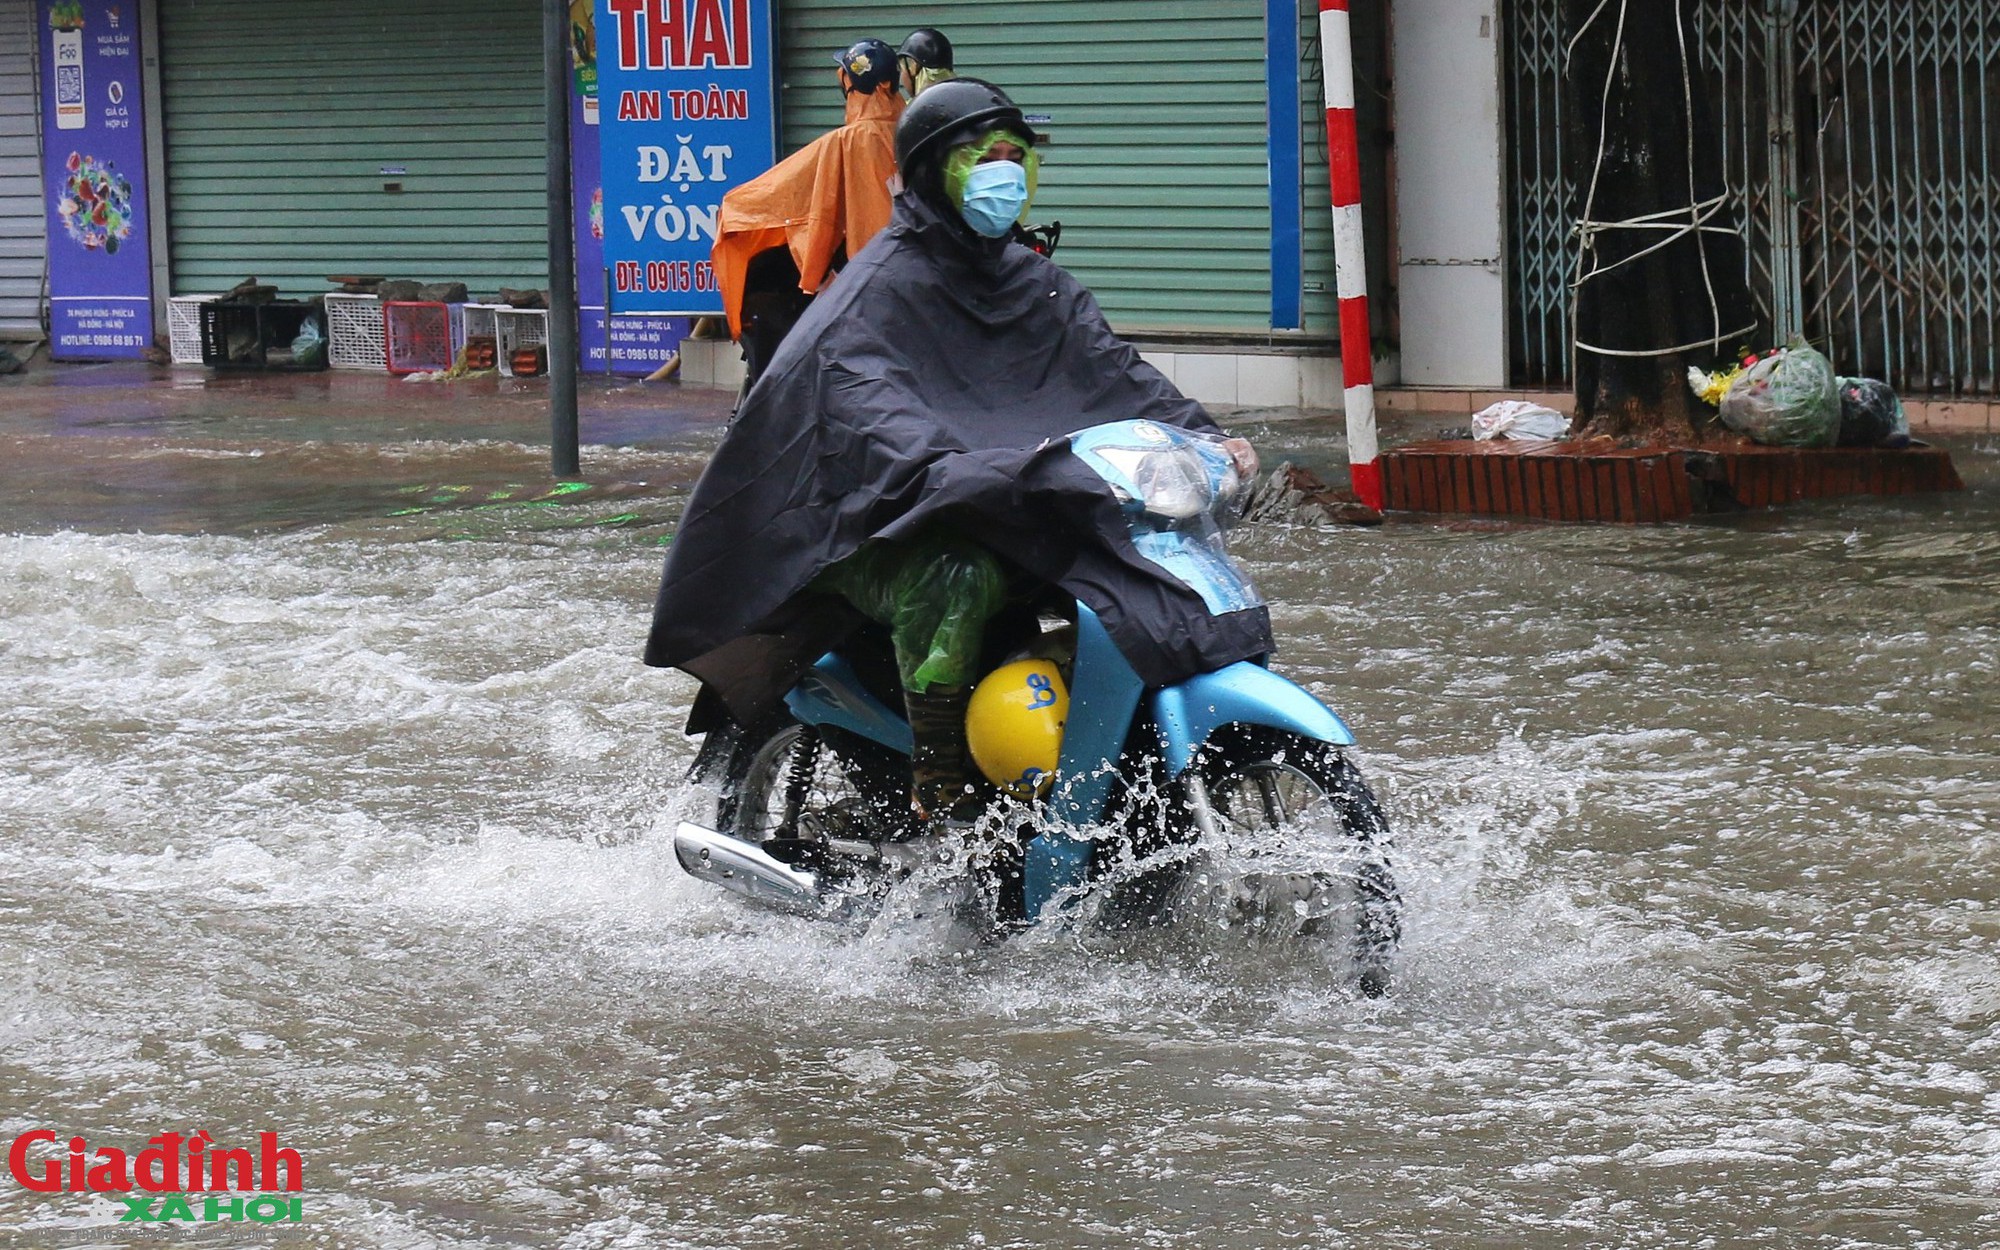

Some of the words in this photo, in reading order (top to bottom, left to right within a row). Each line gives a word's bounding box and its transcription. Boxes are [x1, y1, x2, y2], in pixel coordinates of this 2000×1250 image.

[97, 35, 114, 43] MUA
[617, 89, 661, 121] AN
[668, 83, 748, 120] TOÀN
[637, 134, 732, 192] ĐẶT
[621, 194, 718, 242] VÒN
[616, 261, 643, 293] ĐT:
[646, 261, 689, 294] 0915
[695, 260, 721, 293] 67
[664, 321, 671, 330] LA
[61, 334, 93, 346] HOTLINE:
[134, 335, 143, 347] 71
[590, 347, 626, 360] HOTINE:
[627, 348, 647, 360] 0986
[648, 349, 659, 360] 68
[660, 349, 671, 361] 86
